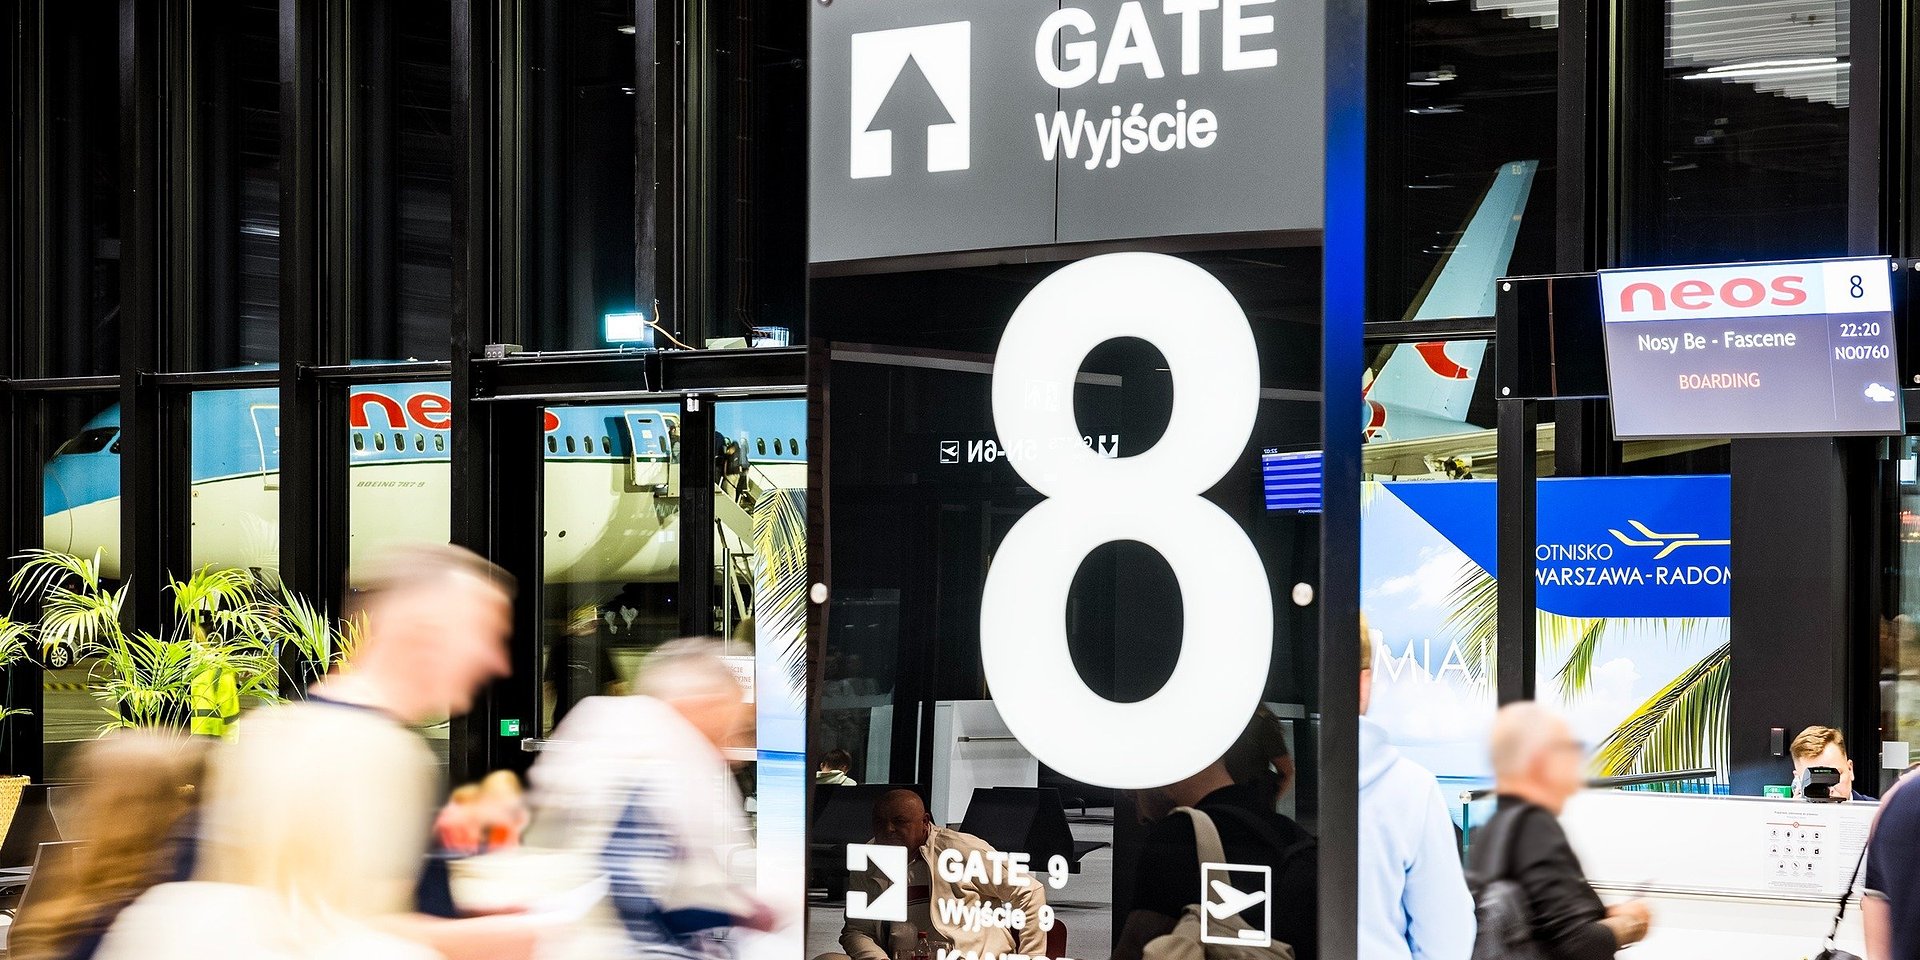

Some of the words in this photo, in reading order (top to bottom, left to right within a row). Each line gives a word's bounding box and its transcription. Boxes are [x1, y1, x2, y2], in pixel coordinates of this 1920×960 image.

[1035, 0, 1278, 89] GATE
[1034, 98, 1219, 170] Wyjście
[1619, 275, 1808, 313] neos
[1849, 275, 1865, 299] 8
[1638, 333, 1679, 354] Nosy
[1683, 332, 1706, 350] Be
[1724, 330, 1797, 349] Fascene
[1840, 322, 1880, 337] 22:20
[1679, 372, 1761, 390] BOARDING
[980, 251, 1274, 789] 8
[1535, 543, 1613, 561] OTNISKO
[937, 848, 1031, 887] GATE
[1047, 854, 1069, 890] 9
[937, 897, 1027, 933] Wyjście
[1038, 904, 1055, 932] 9
